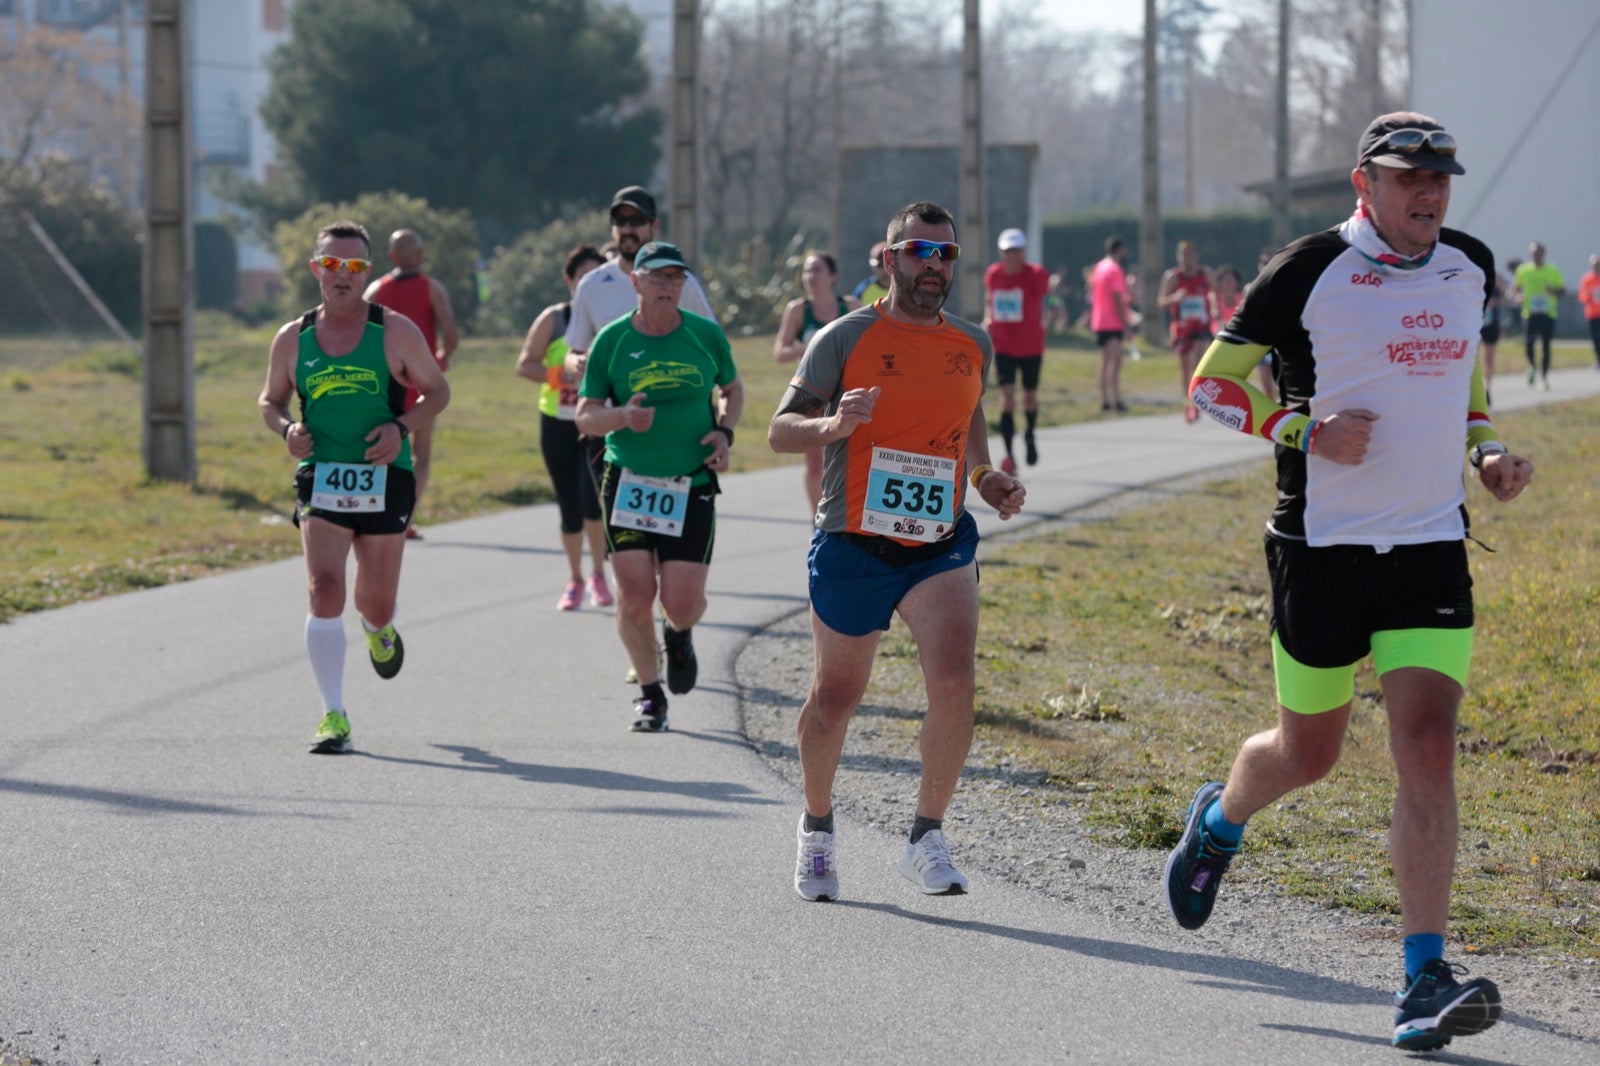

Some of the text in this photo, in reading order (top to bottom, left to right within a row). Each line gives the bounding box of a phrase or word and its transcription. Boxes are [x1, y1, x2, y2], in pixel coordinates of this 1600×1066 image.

[1402, 308, 1444, 331] edp
[896, 454, 911, 464] GRAN
[913, 457, 934, 468] PREMIO
[934, 459, 940, 469] DE
[326, 468, 374, 491] 403
[628, 488, 674, 515] 310
[882, 478, 944, 515] 535
